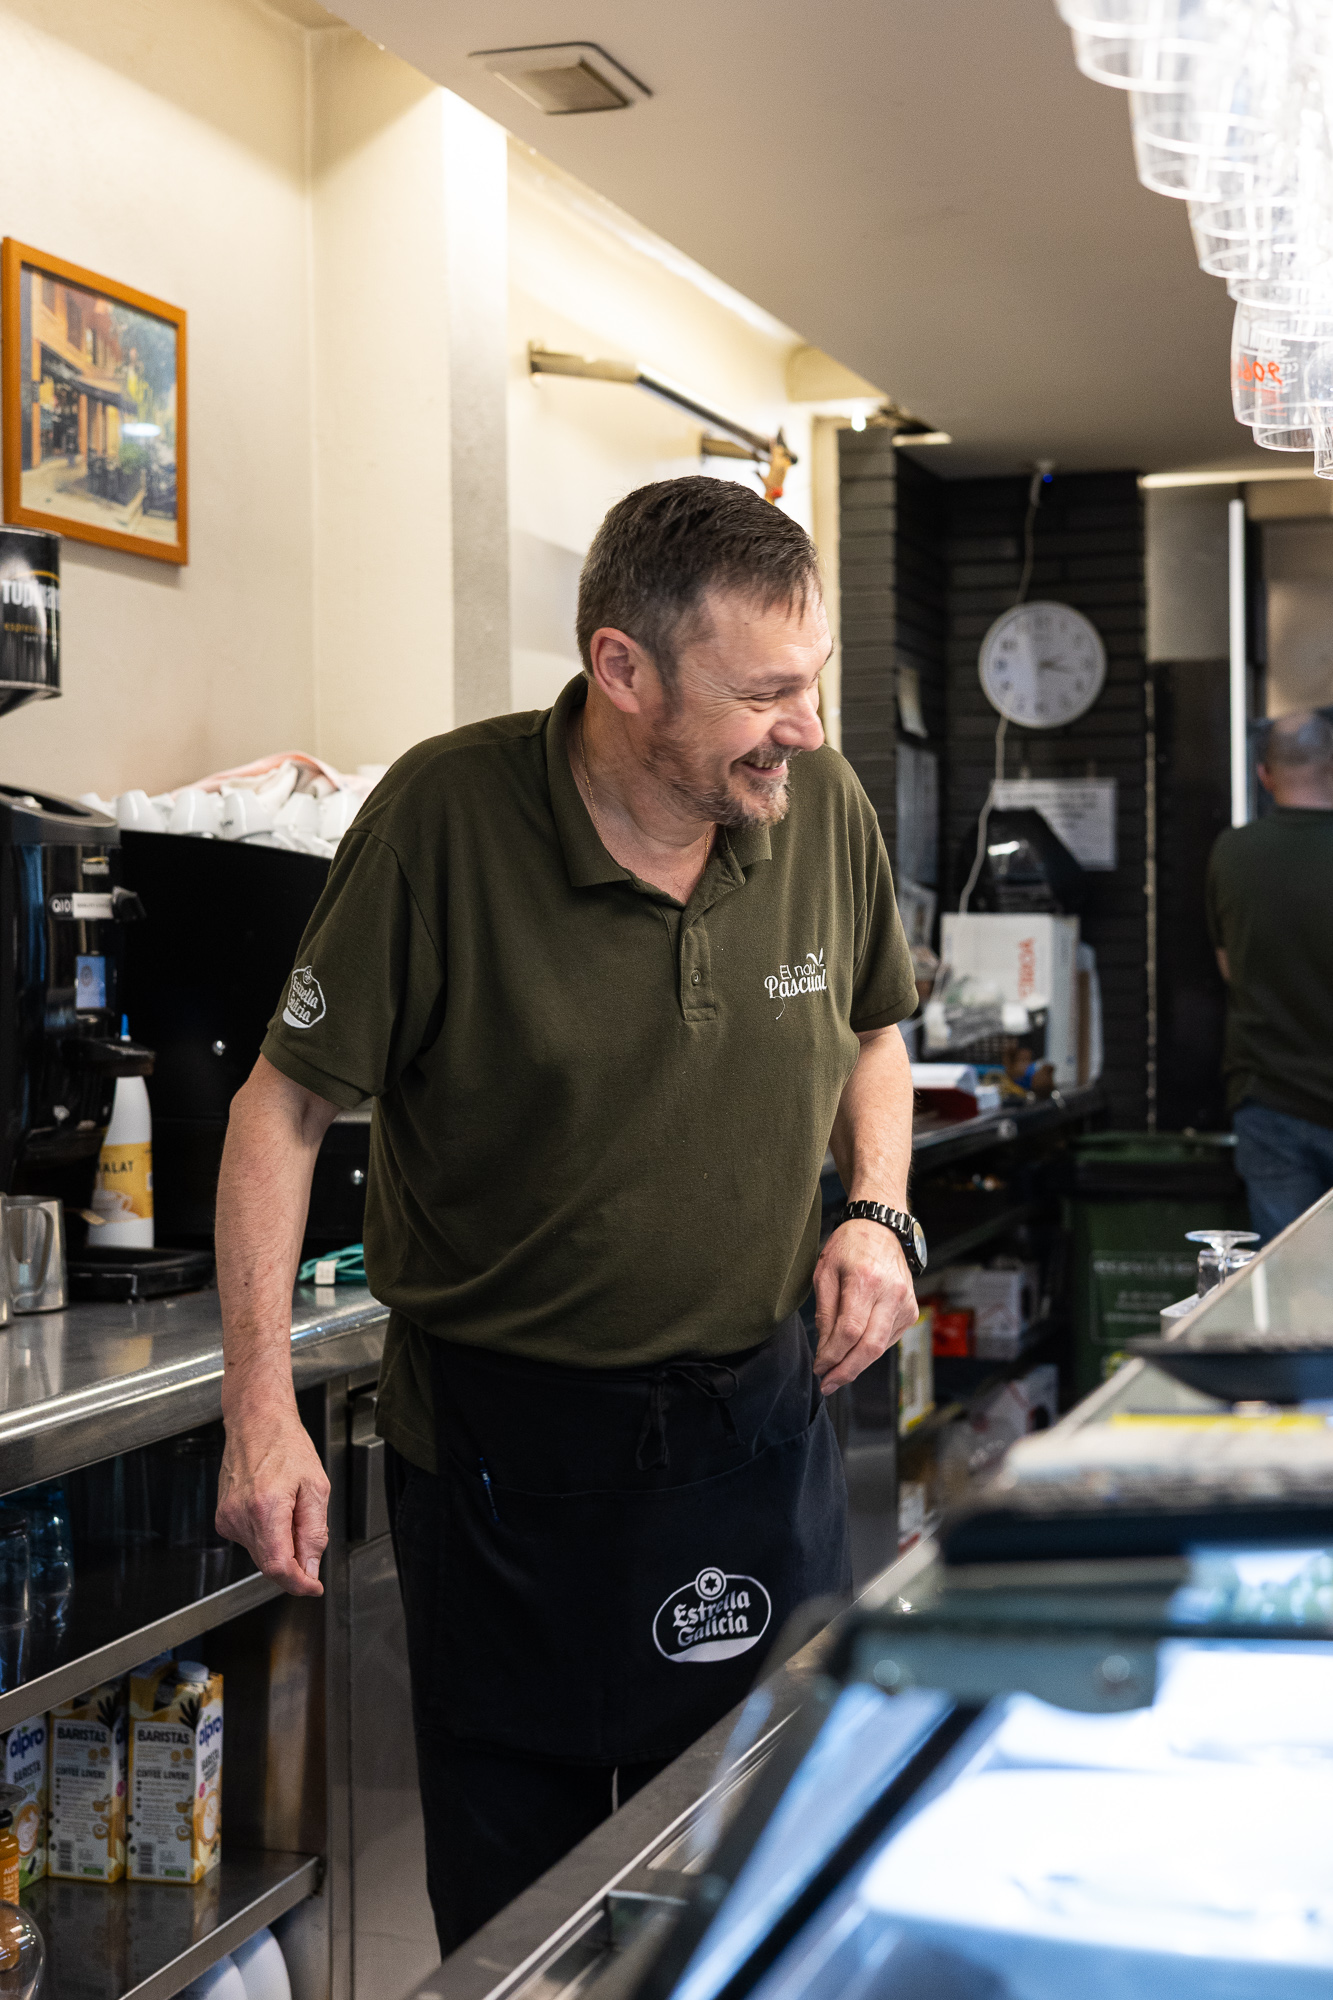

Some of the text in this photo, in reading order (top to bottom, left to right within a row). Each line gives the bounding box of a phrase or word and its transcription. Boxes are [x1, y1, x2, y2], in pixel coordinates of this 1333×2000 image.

[764, 968, 828, 1003] Pascual
[779, 963, 816, 980] El nou
[292, 975, 319, 1009] Estrella
[672, 1589, 752, 1628] Estrella
[677, 1610, 750, 1648] Galicia
[9, 1727, 45, 1759] alpro
[56, 1726, 107, 1744] BARISTAS
[137, 1729, 191, 1745] BARISTAS
[198, 1715, 224, 1748] alpro
